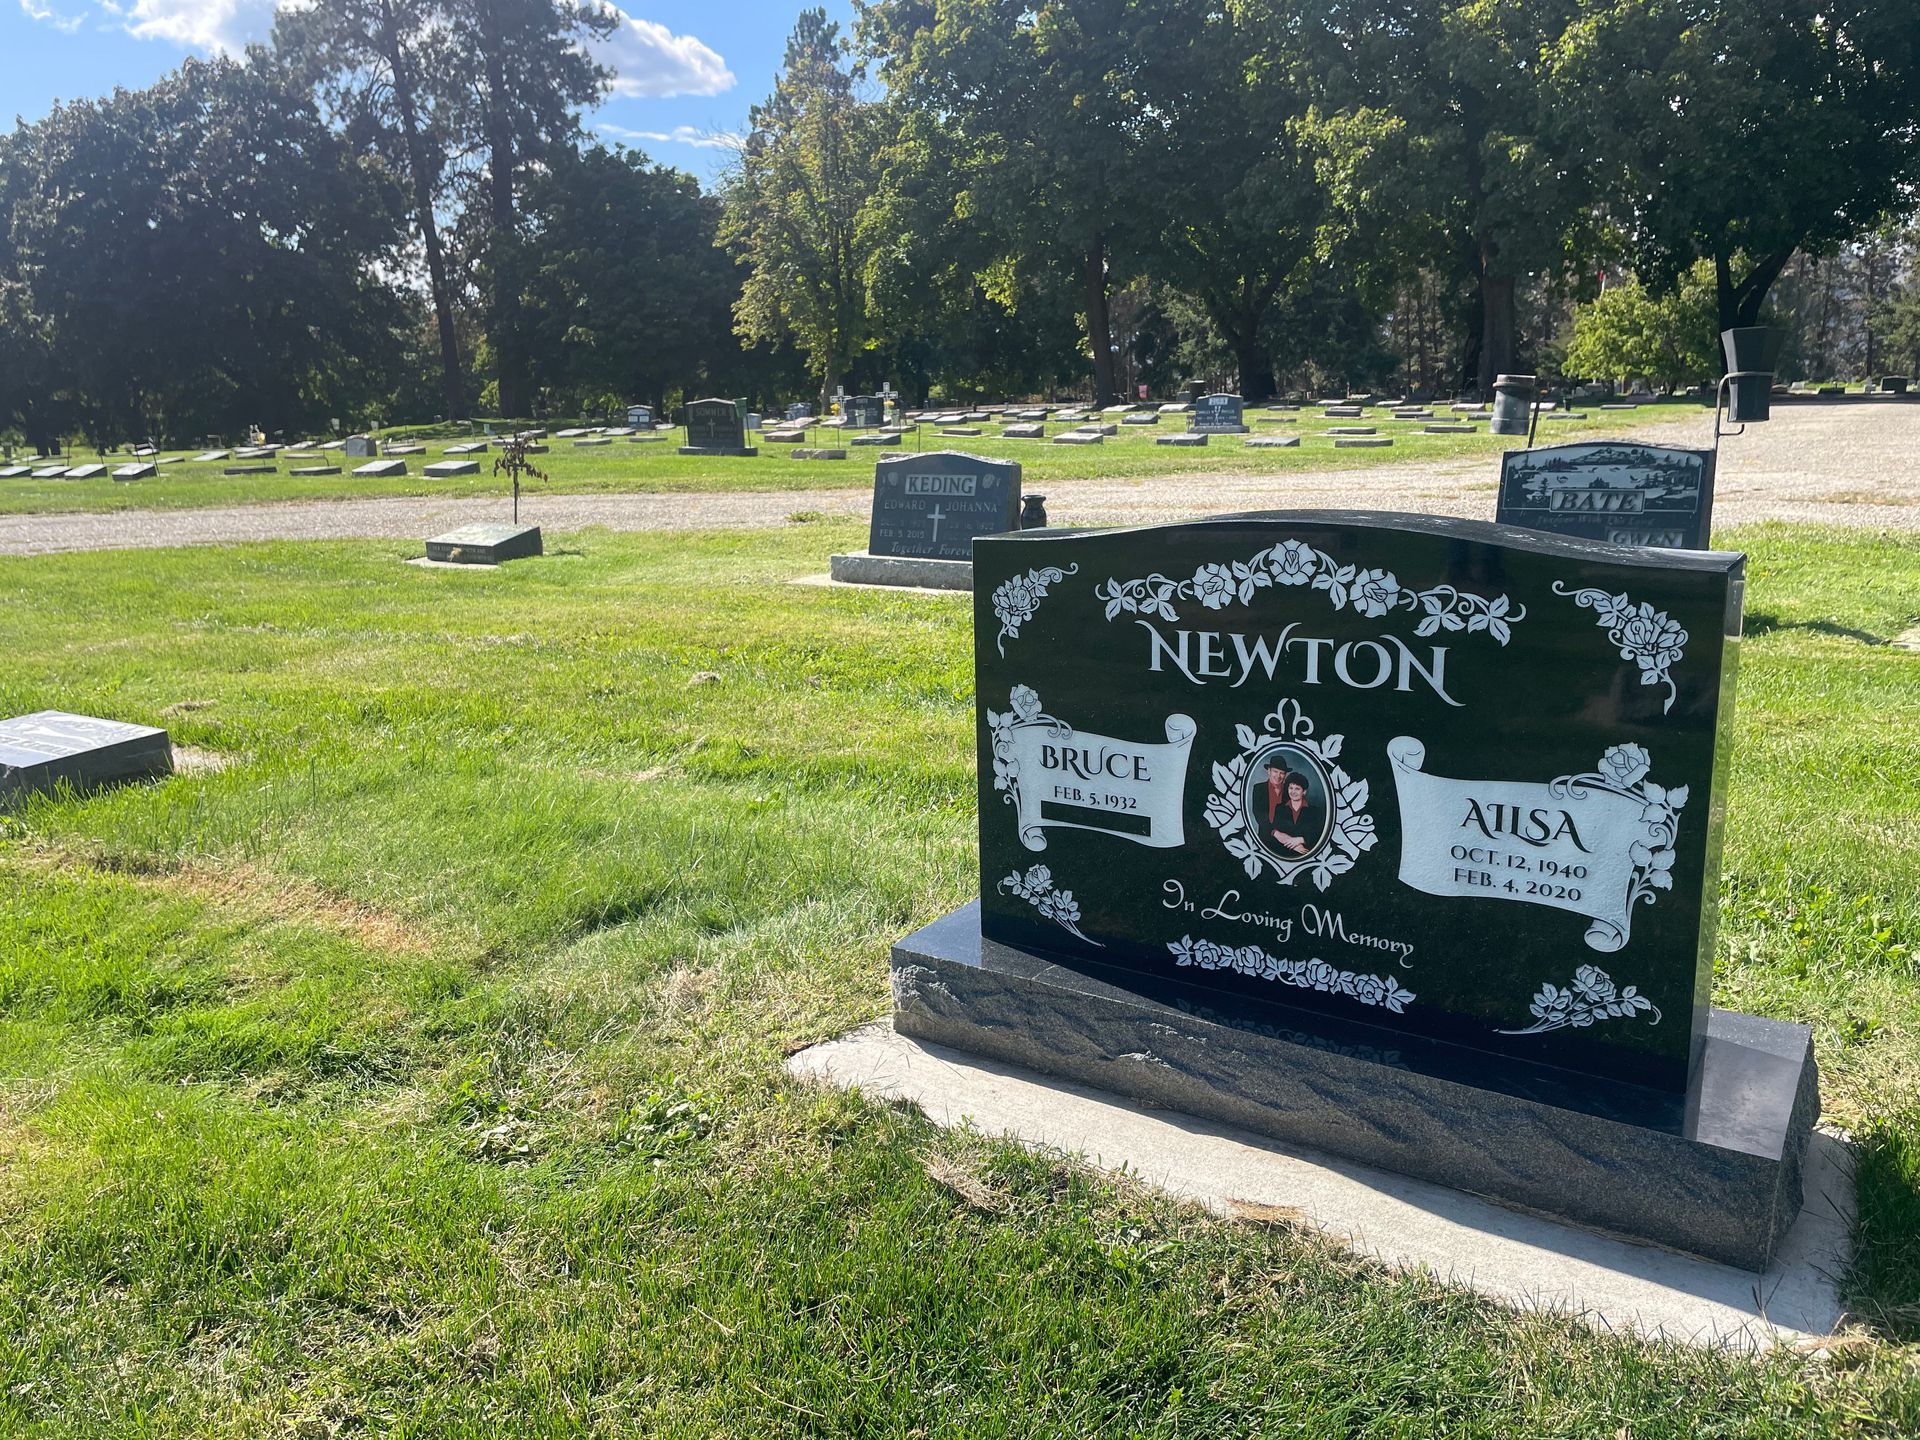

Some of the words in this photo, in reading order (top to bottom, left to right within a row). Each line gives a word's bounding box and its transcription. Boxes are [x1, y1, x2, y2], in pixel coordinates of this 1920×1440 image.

[908, 475, 974, 494] KEDING
[883, 500, 927, 511] EDWARD
[945, 500, 998, 513] JOHANNA
[1556, 492, 1638, 512] BATE
[890, 541, 934, 555] Together
[938, 543, 973, 557] Foreve
[1134, 619, 1467, 708] NEWTON
[1038, 745, 1152, 782] BRUCE
[1054, 785, 1086, 802] FEB.
[1089, 792, 1100, 806] 5,
[1105, 794, 1138, 810] 1932
[1460, 797, 1594, 854] AILSA
[1450, 844, 1501, 867] OCT.
[1507, 855, 1532, 873] 12,
[1538, 859, 1588, 880] 1940
[1454, 867, 1497, 889] FEB.
[1503, 879, 1520, 894] 4,
[1526, 880, 1582, 902] 2020
[1162, 878, 1195, 913] In
[1201, 889, 1294, 943] Loving
[1301, 903, 1415, 969] Memory
